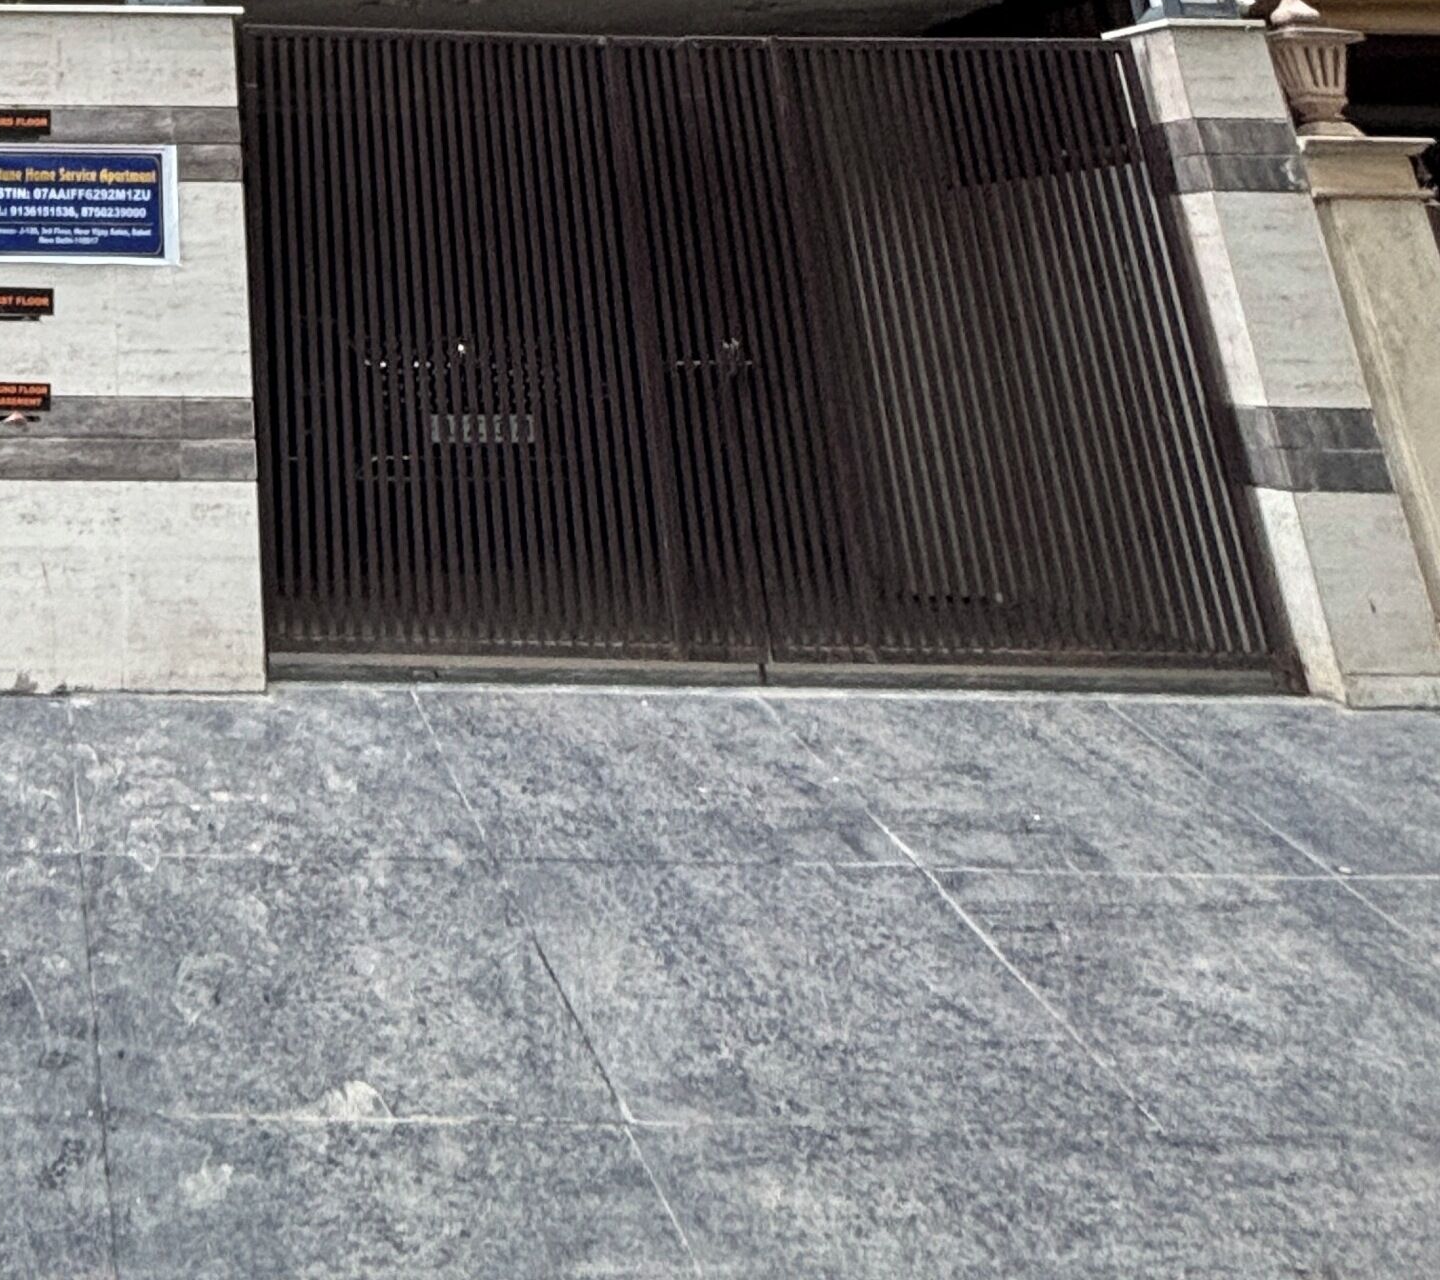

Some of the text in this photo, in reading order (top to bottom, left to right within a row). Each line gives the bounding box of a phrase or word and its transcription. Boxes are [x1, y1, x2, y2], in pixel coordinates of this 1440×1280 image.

[25, 167, 56, 182] Home
[59, 167, 97, 183] Service
[100, 168, 156, 186] Apartment
